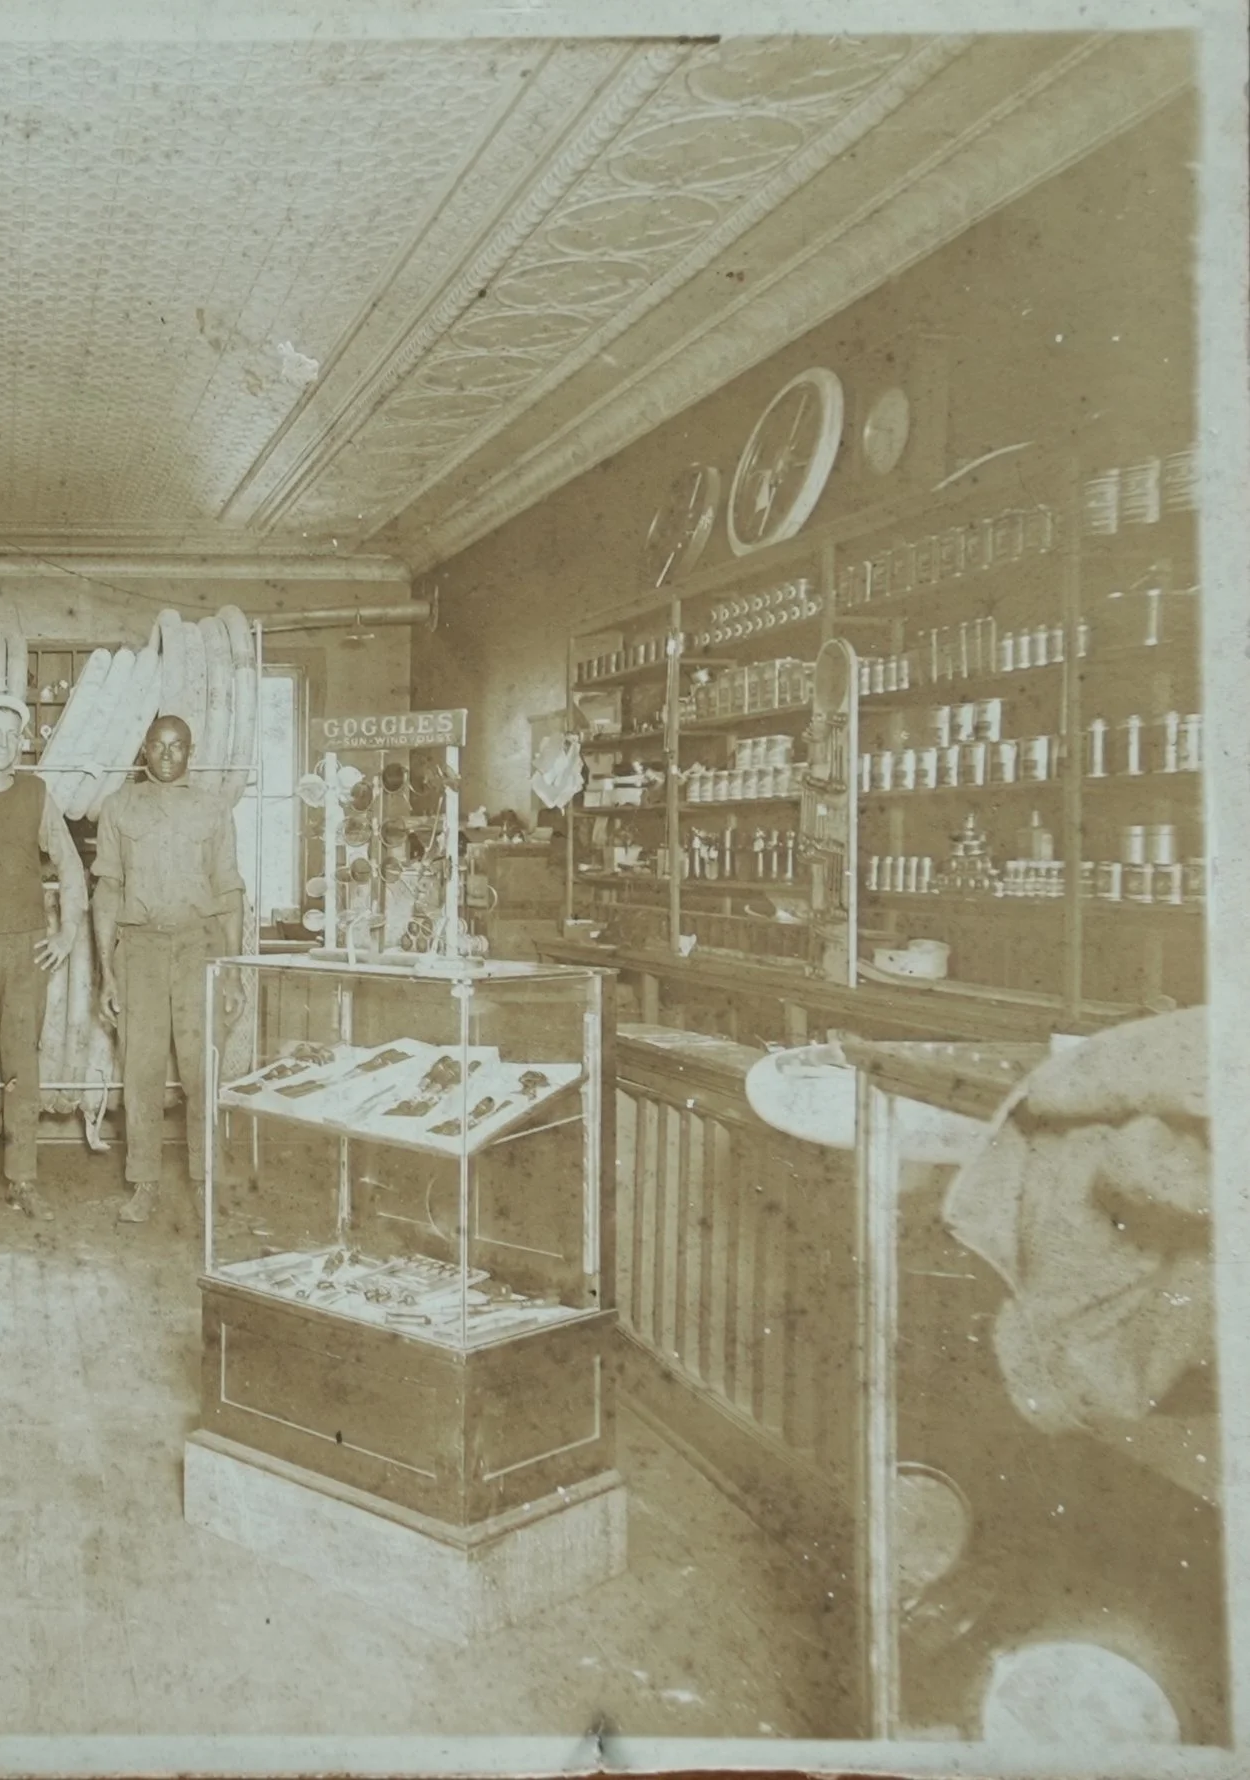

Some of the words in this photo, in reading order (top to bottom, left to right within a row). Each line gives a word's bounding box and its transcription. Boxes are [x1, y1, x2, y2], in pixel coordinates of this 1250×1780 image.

[323, 713, 453, 738] GOGGLES
[344, 736, 367, 746] SUN
[375, 735, 407, 745] WIND
[416, 733, 452, 744] DUST
